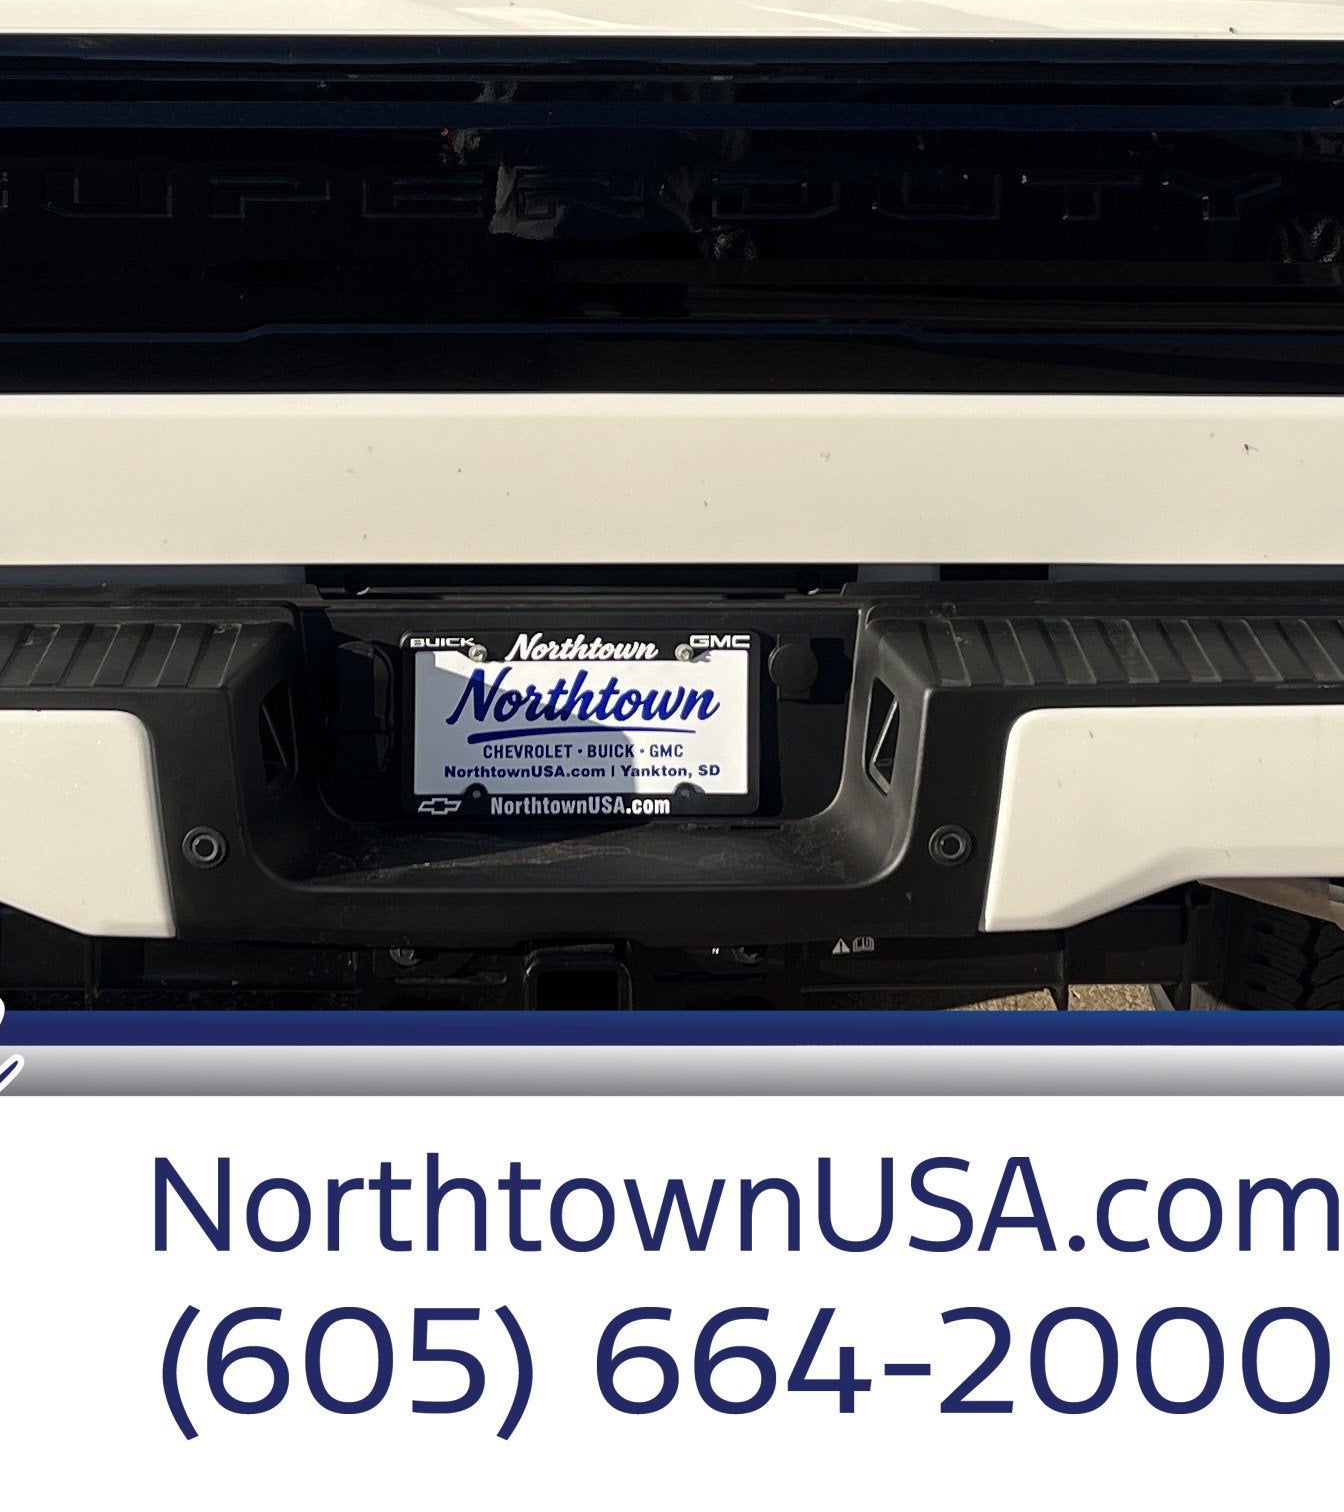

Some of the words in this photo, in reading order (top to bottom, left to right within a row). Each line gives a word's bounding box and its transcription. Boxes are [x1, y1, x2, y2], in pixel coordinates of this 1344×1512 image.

[711, 168, 1287, 221] DUTY
[410, 637, 475, 648] BUICK
[505, 632, 659, 661] Northtown
[689, 634, 751, 648] GMC
[445, 666, 721, 726] Northtown
[483, 744, 573, 759] CHEVROLET
[587, 744, 635, 758] BUICK
[649, 744, 684, 758] GMC
[444, 765, 606, 778] NorthtownUSA.com
[620, 764, 693, 779] Yankton,
[698, 764, 721, 777] SD
[490, 795, 671, 816] NorthtownUSA.com
